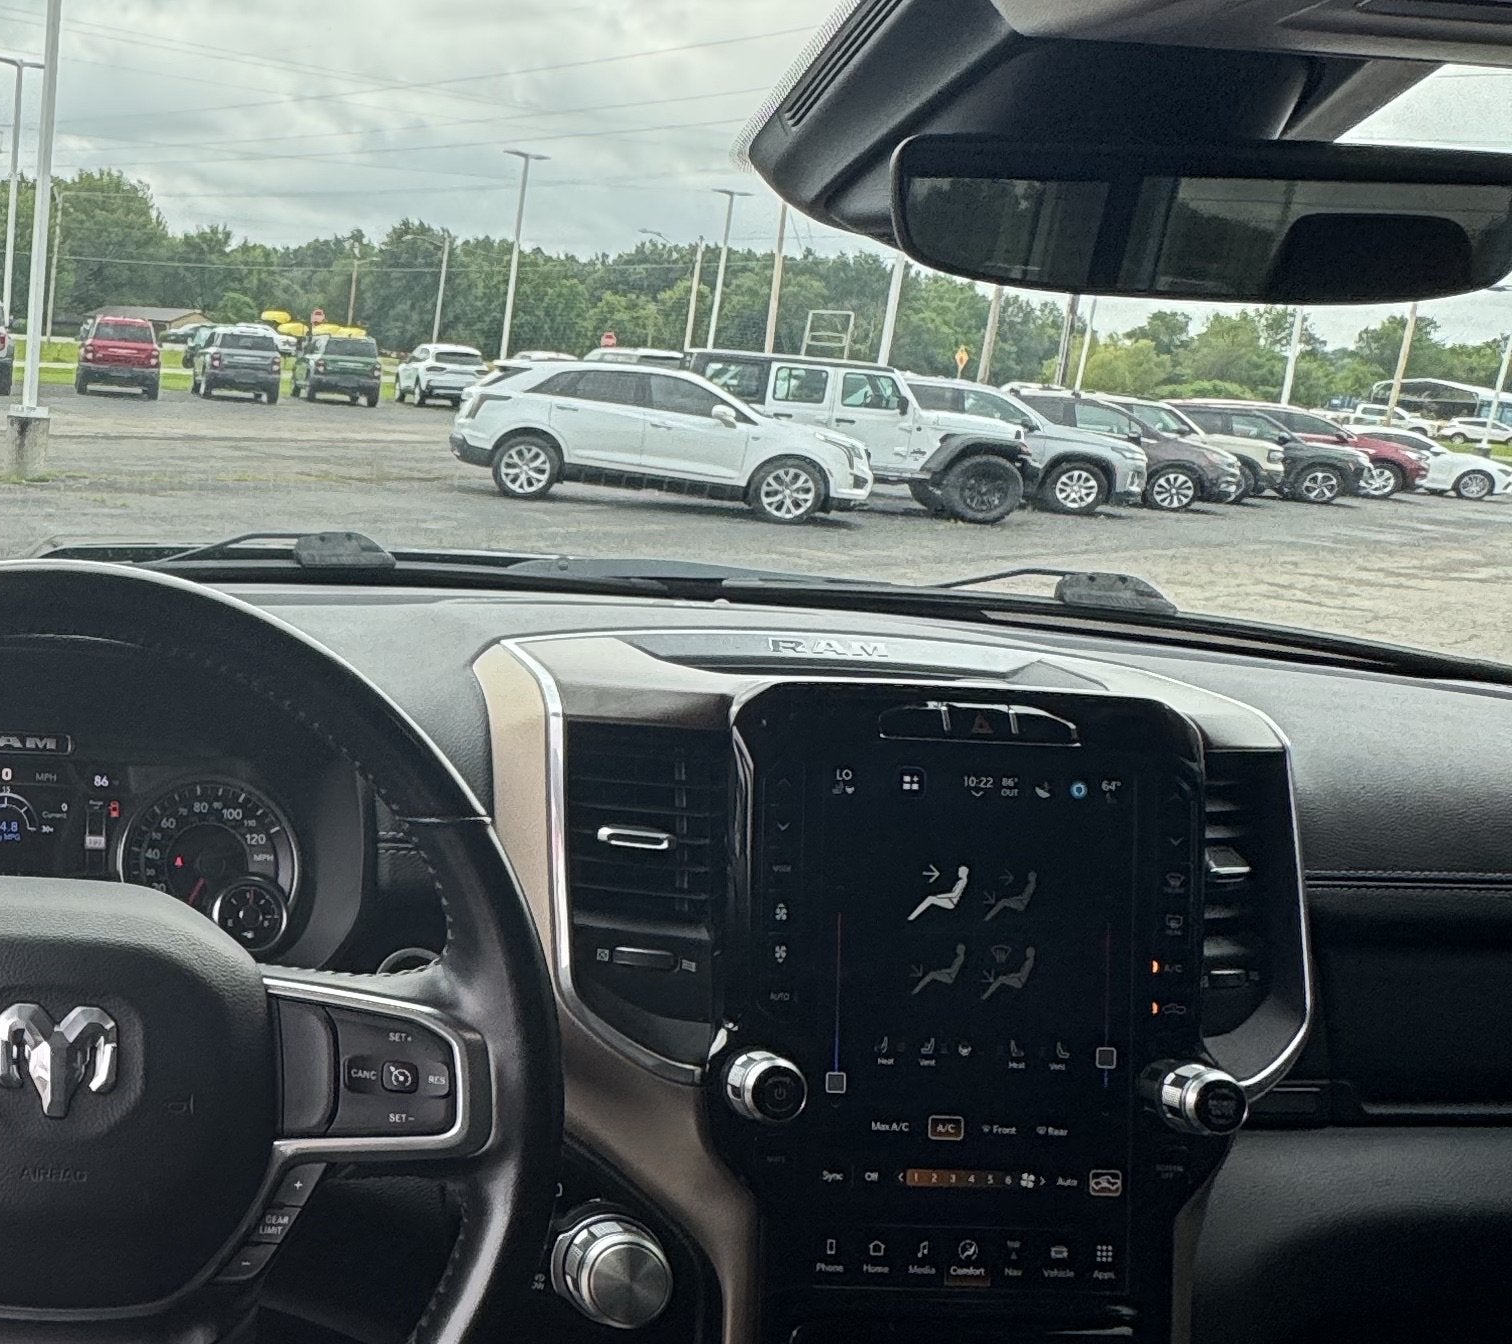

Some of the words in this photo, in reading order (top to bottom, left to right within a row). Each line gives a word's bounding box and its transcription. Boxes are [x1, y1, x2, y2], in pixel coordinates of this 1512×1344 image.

[768, 637, 888, 658] RAM
[1, 767, 12, 781] 0
[35, 772, 57, 782] MPH
[836, 769, 853, 781] LO
[94, 775, 109, 787] 86
[964, 776, 994, 788] 10:22
[1001, 788, 1019, 797] OUT
[61, 803, 68, 812] 0
[193, 802, 208, 813] 80
[223, 809, 243, 820] 100
[161, 818, 176, 829] 60
[245, 834, 266, 845] 120
[145, 848, 160, 859] 40
[253, 854, 274, 862] MPH
[351, 1068, 377, 1081] CANC
[428, 1075, 446, 1085] RES
[891, 1122, 910, 1132] A/C
[937, 1124, 956, 1134] A/C
[993, 1125, 1017, 1135] Front
[1048, 1127, 1069, 1137] Rear
[822, 1170, 844, 1183] Sync
[914, 1173, 919, 1182] 1
[931, 1173, 938, 1183] 2
[950, 1174, 956, 1183] 3
[968, 1174, 976, 1183] 4
[988, 1175, 994, 1184] 5
[1005, 1175, 1012, 1185] 6
[1056, 1176, 1078, 1187] Auto
[259, 1226, 284, 1235] LIMIT
[816, 1262, 844, 1272] Phone
[863, 1263, 890, 1273] Home
[908, 1264, 936, 1274] Media
[950, 1266, 985, 1276] Comfort
[1004, 1268, 1023, 1276] Nav
[1042, 1268, 1075, 1278] Vehicle
